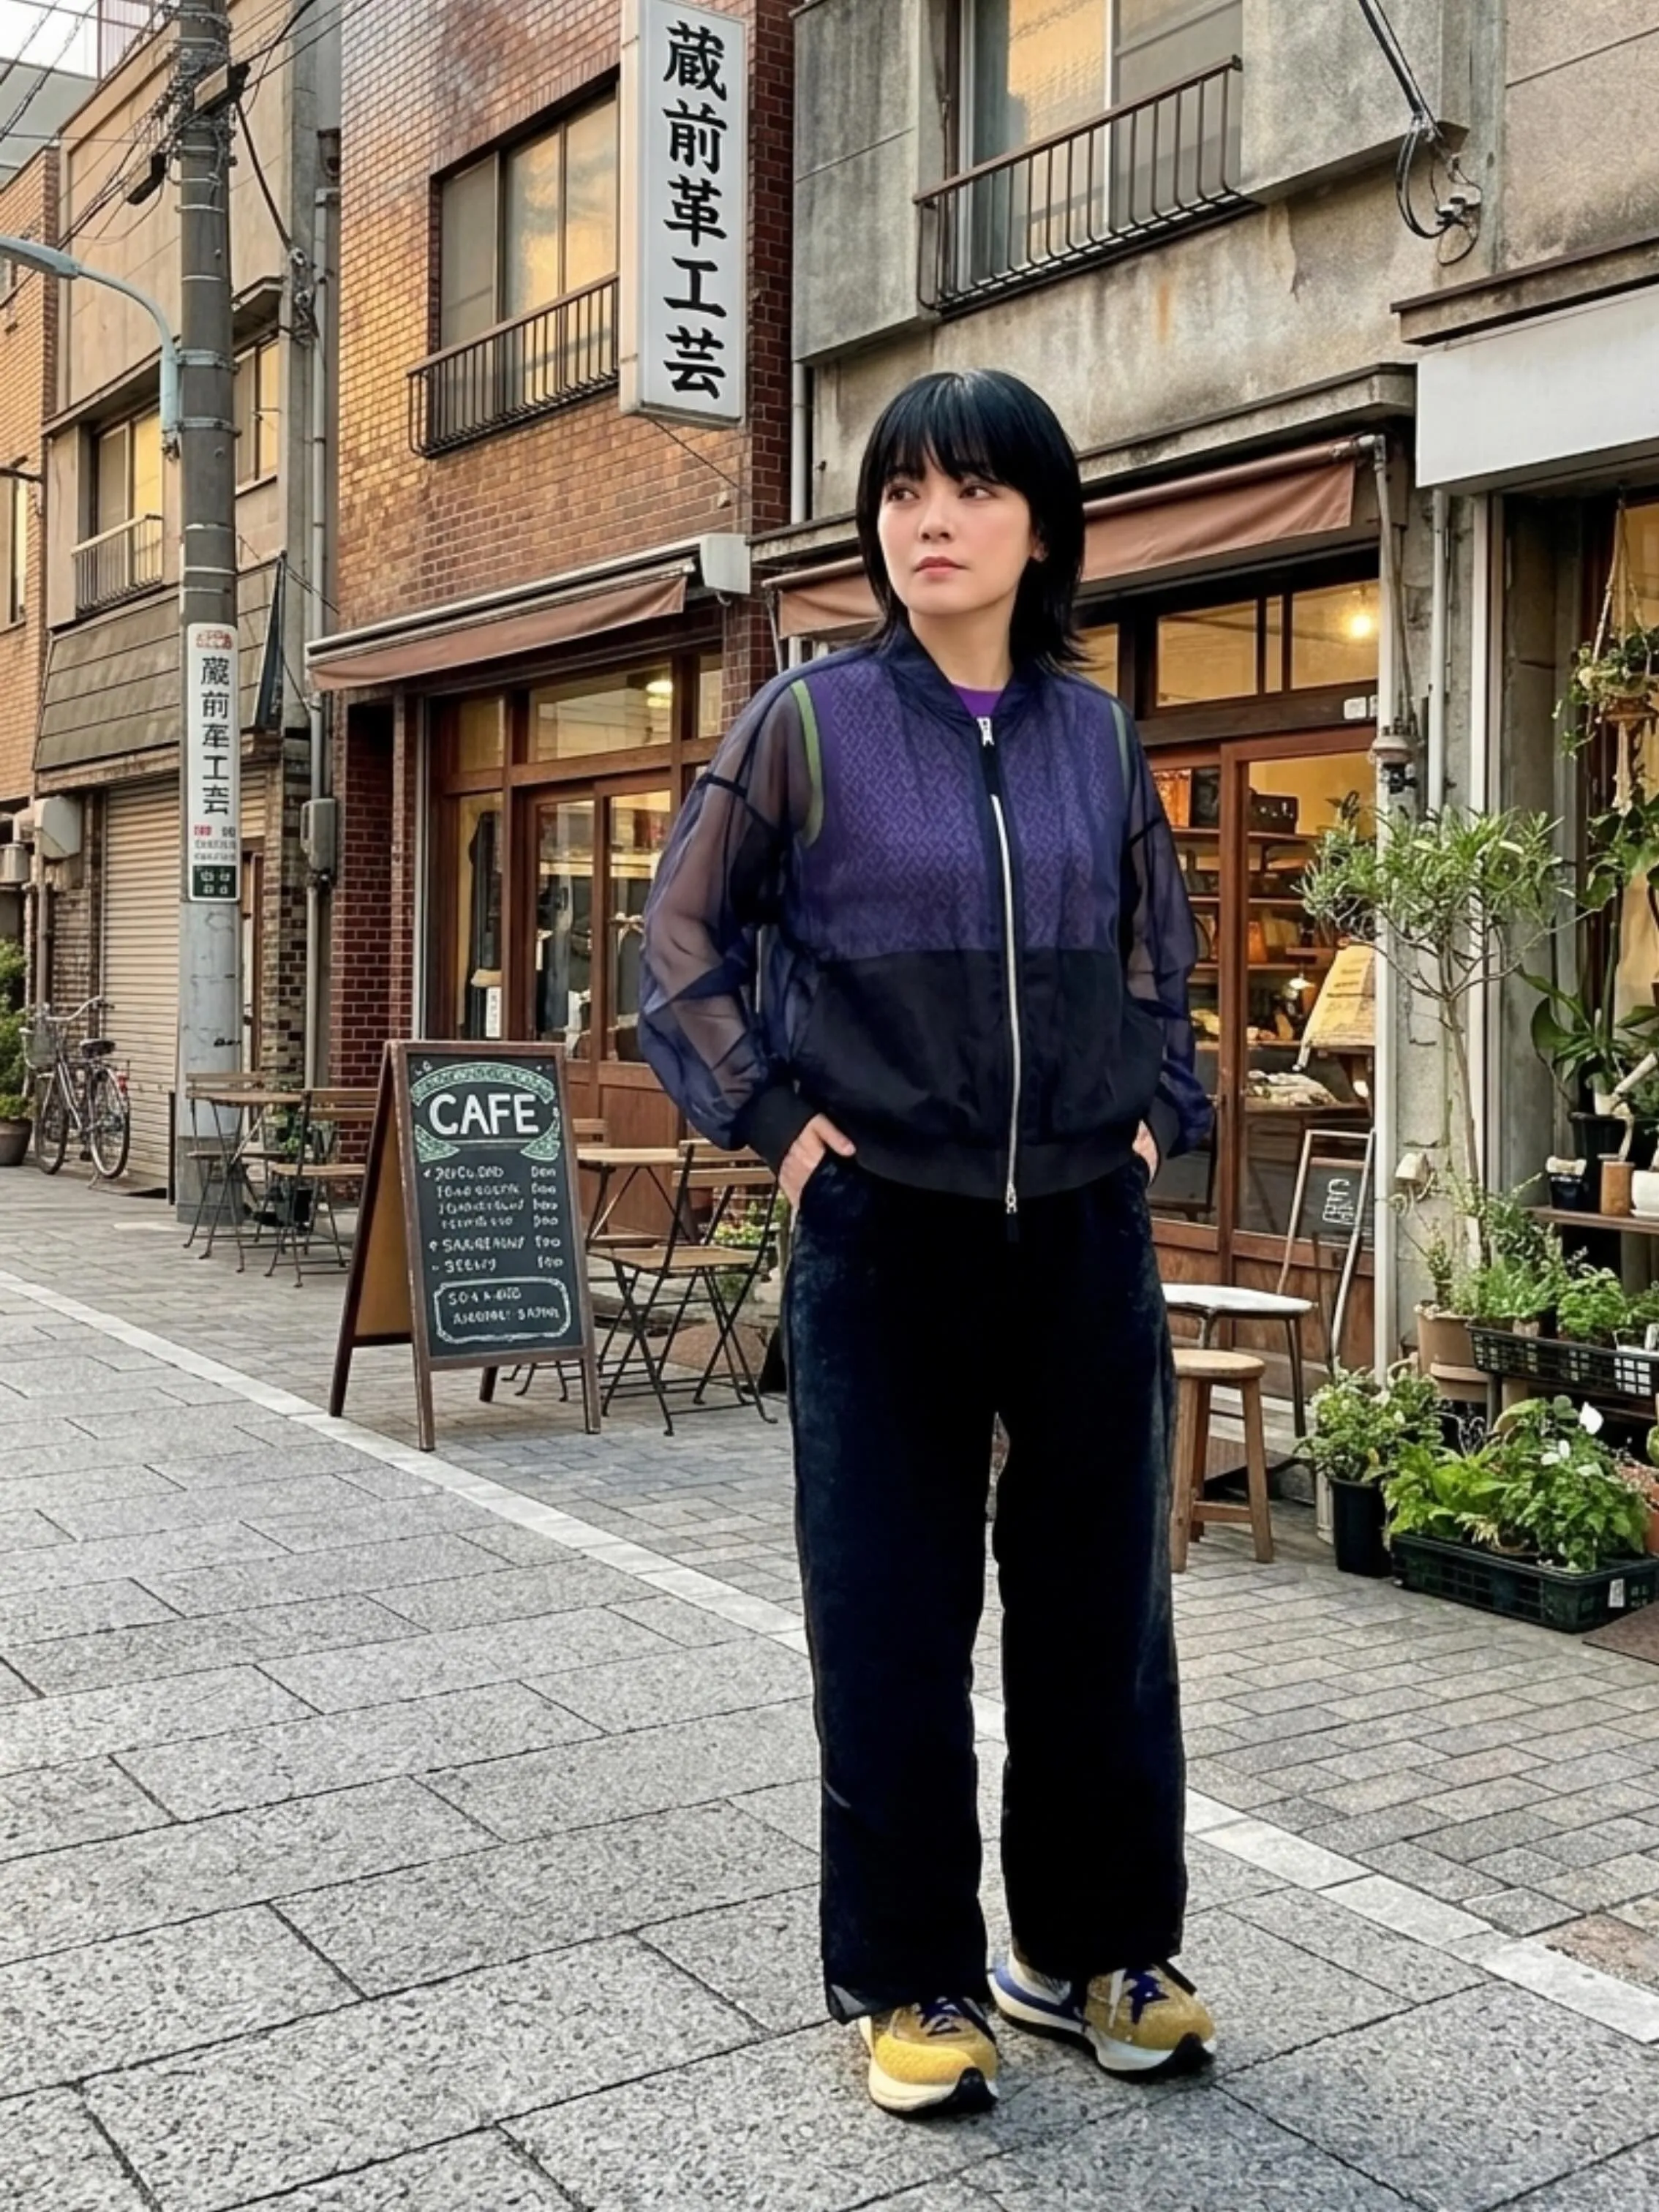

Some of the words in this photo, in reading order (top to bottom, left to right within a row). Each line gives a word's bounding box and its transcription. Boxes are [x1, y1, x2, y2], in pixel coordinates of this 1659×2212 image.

[663, 20, 727, 399] 蔵前革工芸
[429, 1094, 539, 1135] CAFE
